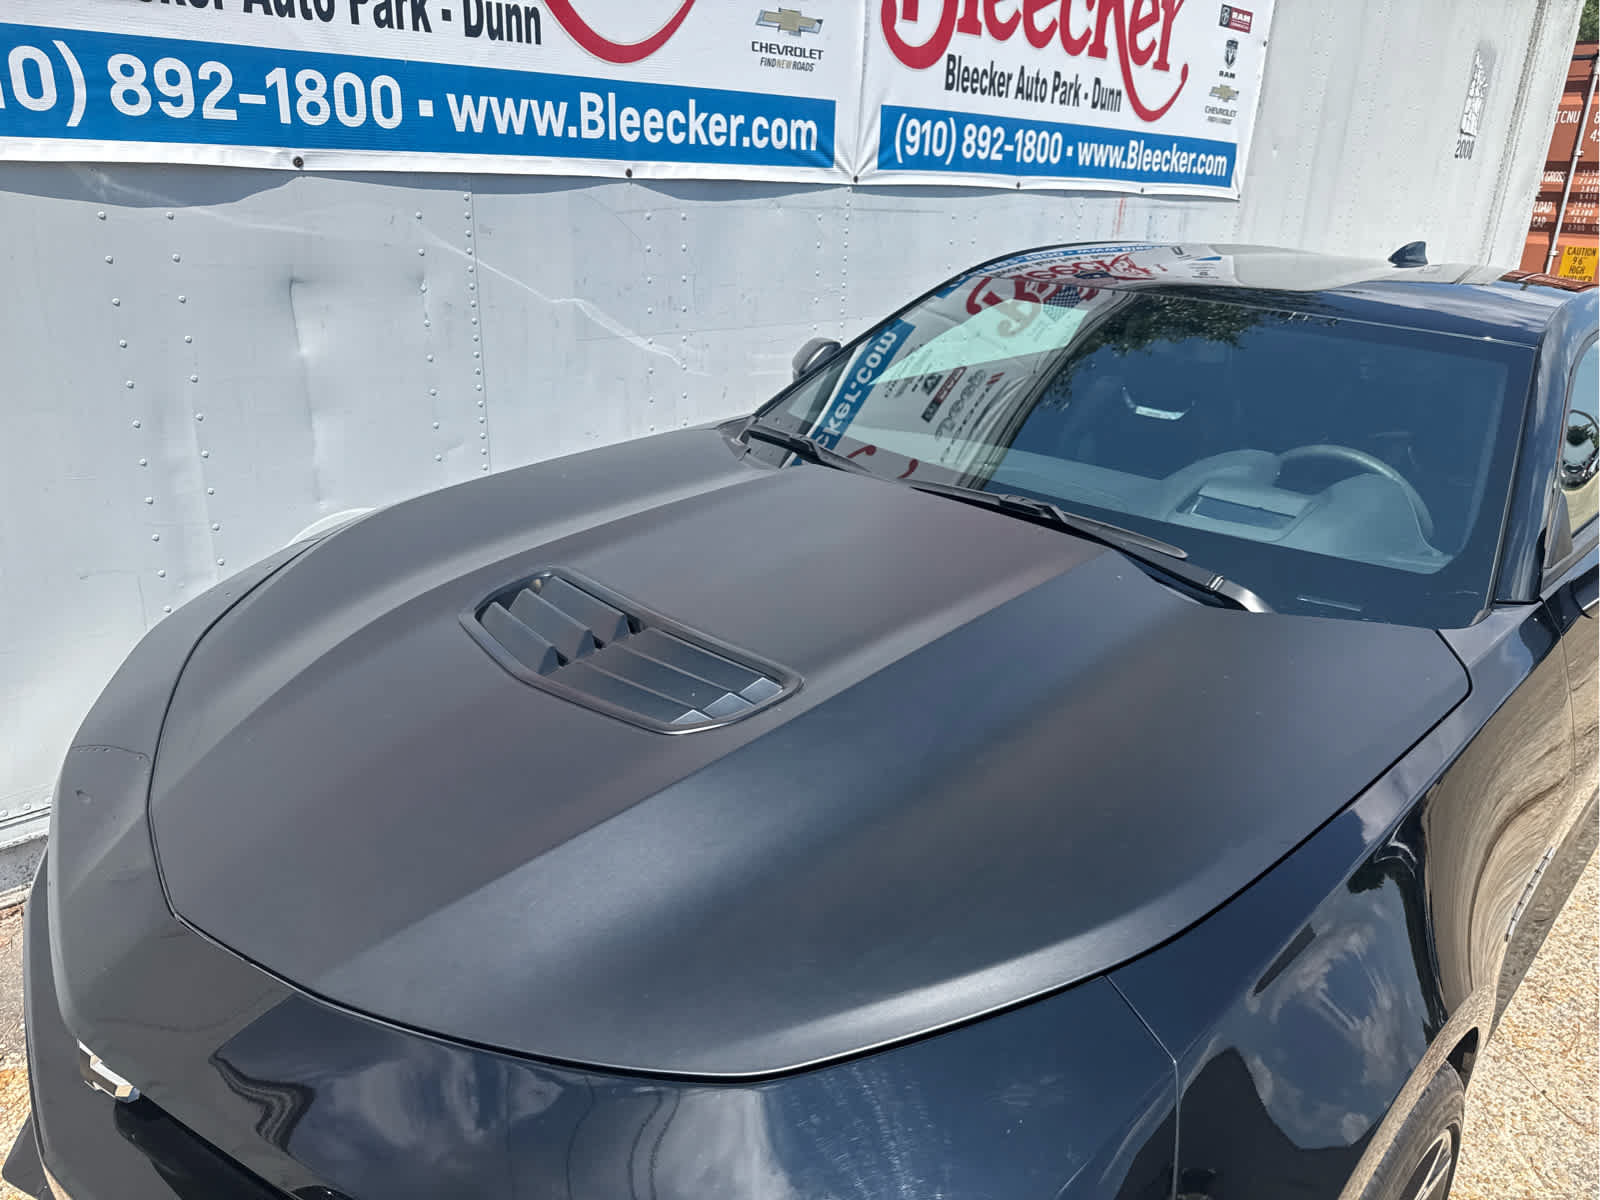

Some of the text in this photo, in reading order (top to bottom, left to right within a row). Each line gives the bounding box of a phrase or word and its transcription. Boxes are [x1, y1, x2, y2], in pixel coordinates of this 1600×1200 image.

[464, 0, 542, 45] Dunn
[751, 40, 824, 61] CHEVROLET
[760, 56, 776, 68] FIND
[792, 60, 815, 72] ROADS
[881, 0, 1188, 122] eecker
[944, 53, 1122, 112] Bleecker Auto Park Dunn
[1218, 70, 1236, 79] RAM
[106, 52, 402, 130] 892-1800
[446, 91, 818, 152] www.Bleecker.com
[895, 113, 1227, 177] (910) 892-1800 www.Bleecker.com
[1567, 246, 1596, 256] CAUTION
